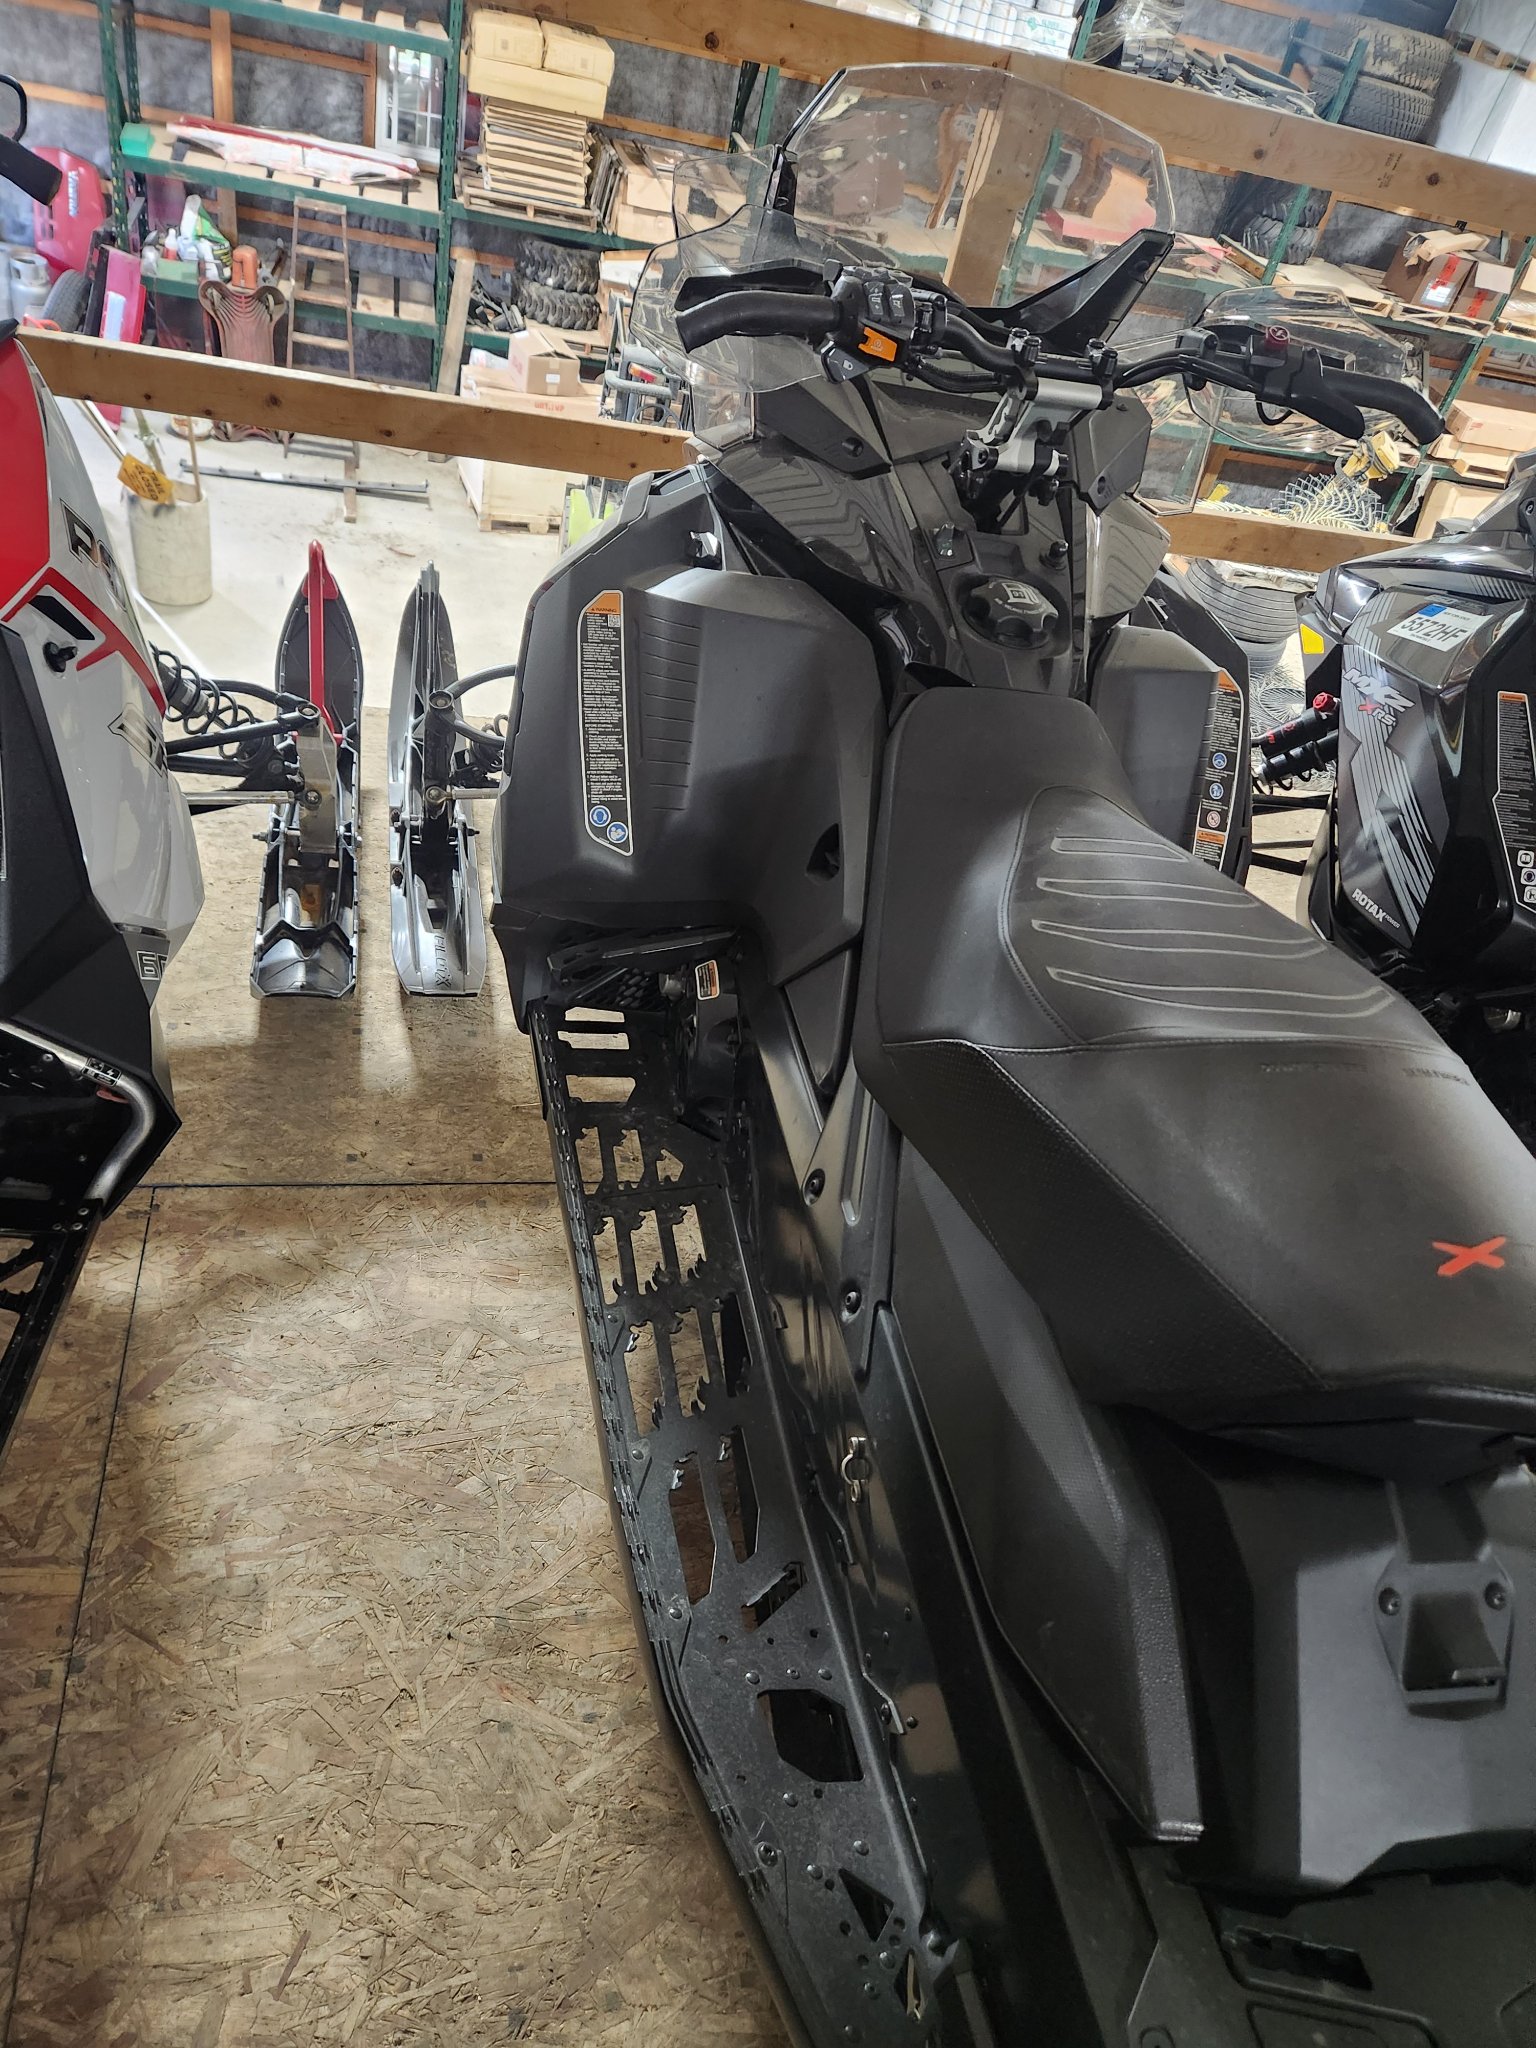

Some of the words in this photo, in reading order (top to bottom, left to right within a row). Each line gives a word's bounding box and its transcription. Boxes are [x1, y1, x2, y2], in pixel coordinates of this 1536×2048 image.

[1400, 616, 1469, 642] 5572HF
[1343, 668, 1416, 714] MXZ
[1351, 888, 1387, 923] ROTAX
